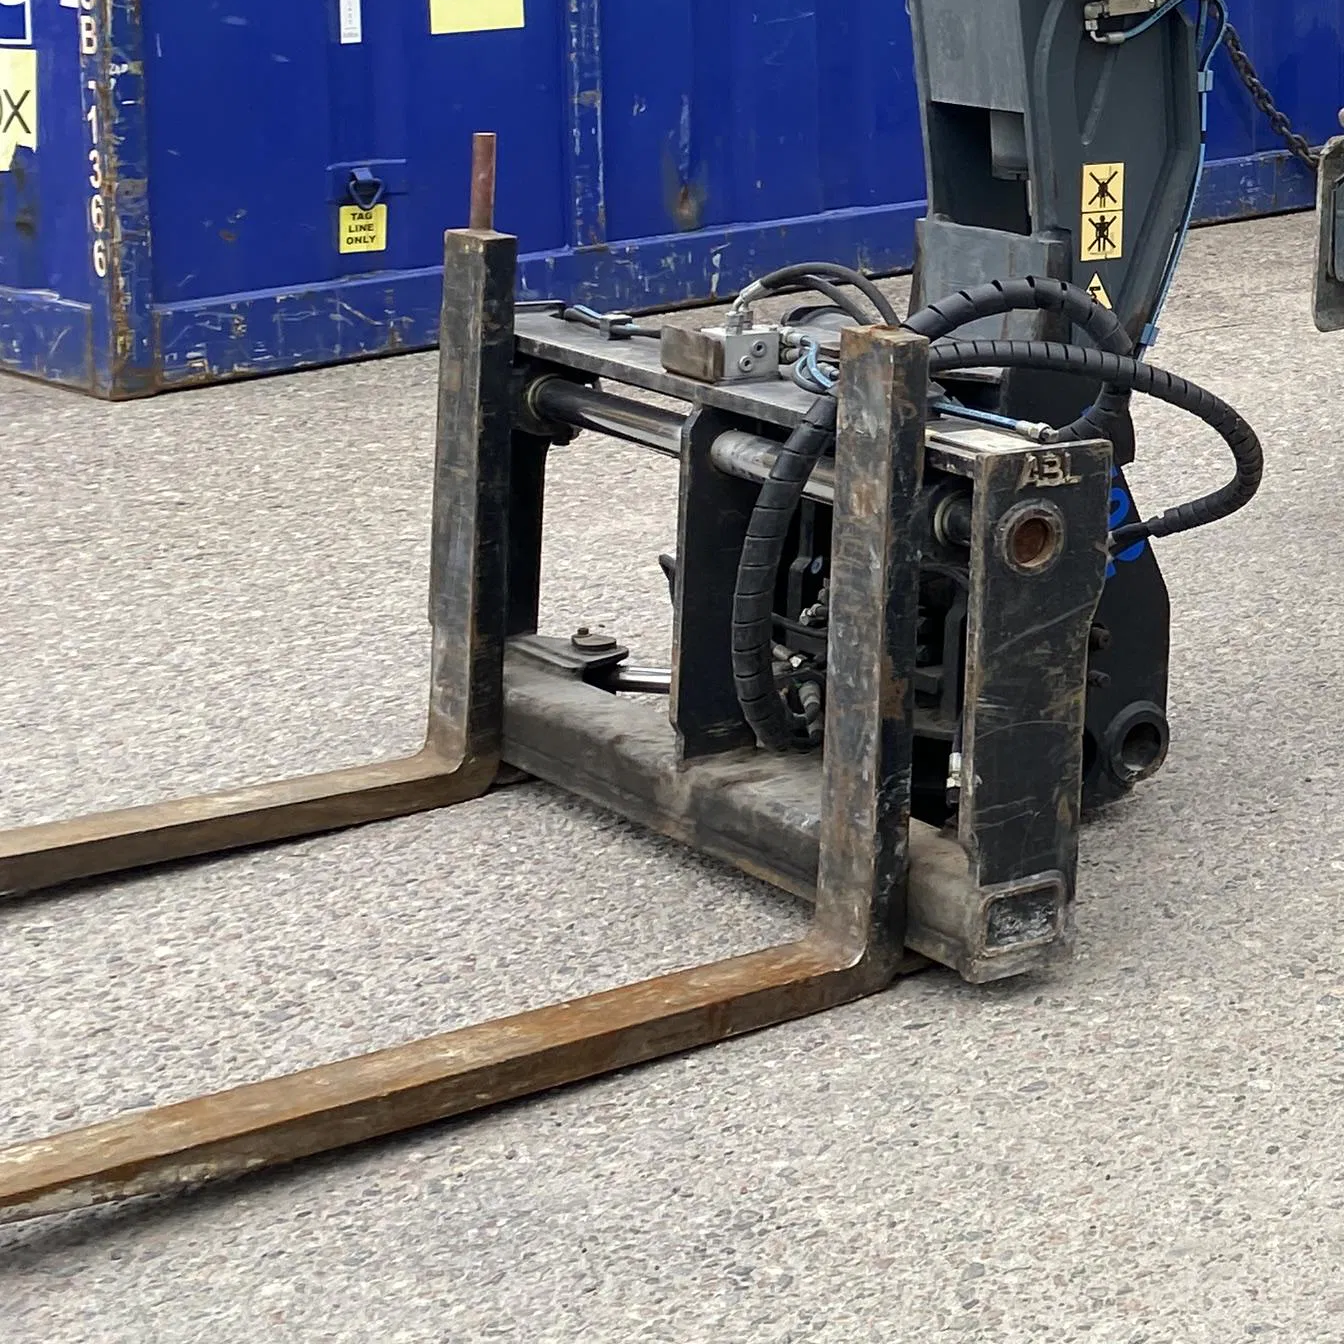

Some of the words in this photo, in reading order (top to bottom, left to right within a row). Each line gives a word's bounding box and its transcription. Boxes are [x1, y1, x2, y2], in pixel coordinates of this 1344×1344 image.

[0, 89, 32, 135] X
[351, 212, 373, 221] TAG
[348, 223, 374, 233] LINE
[346, 235, 376, 245] ONLY
